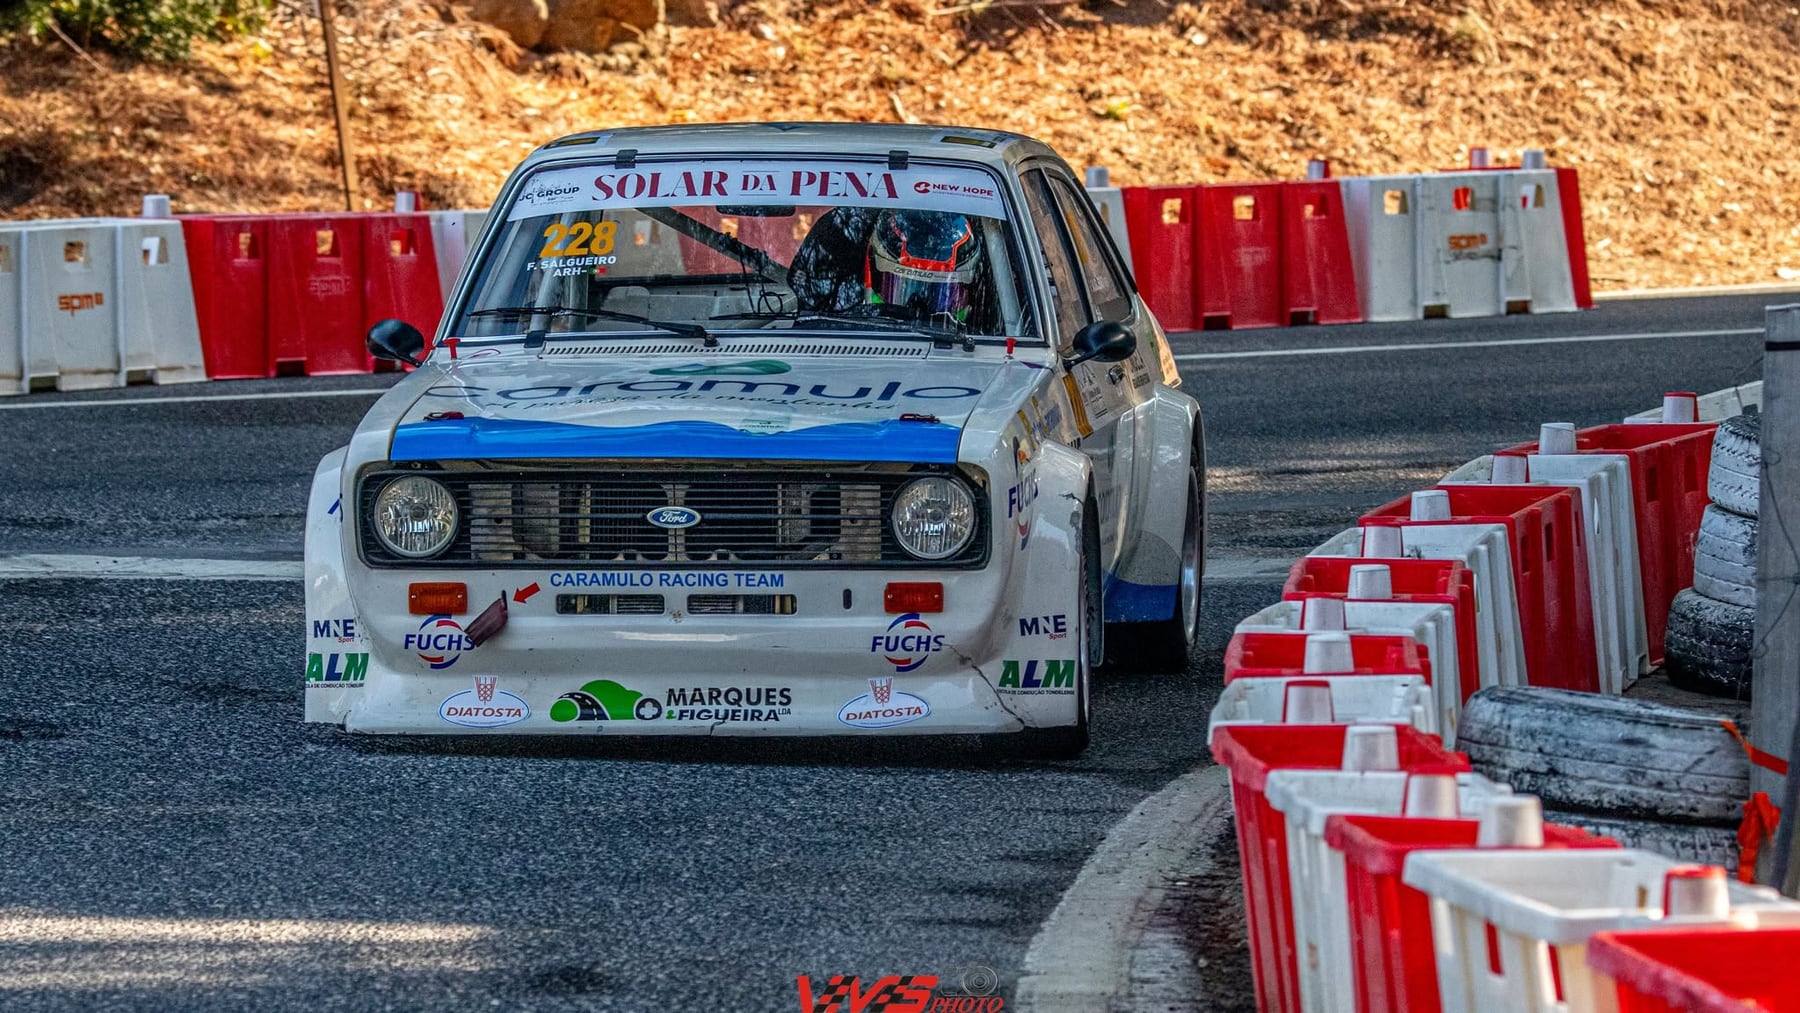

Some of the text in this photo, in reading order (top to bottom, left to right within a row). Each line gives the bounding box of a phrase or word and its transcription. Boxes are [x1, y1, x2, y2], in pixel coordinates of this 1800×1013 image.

[537, 186, 580, 198] GROUP
[591, 171, 899, 201] SOLAR DA PENA
[932, 183, 960, 192] NEW
[963, 186, 994, 197] HOPE
[539, 220, 618, 259] 228
[527, 256, 617, 271] F. SALGUEIRO
[425, 380, 982, 401] caramulo
[1008, 467, 1039, 519] FUCHS
[659, 510, 688, 523] Ford
[550, 572, 785, 588] CARAMULO RACING TEAM
[404, 633, 475, 651] FUCHS
[871, 634, 945, 652] FUCHS
[1048, 631, 1067, 640] Sport
[305, 652, 369, 682] ALM
[998, 659, 1076, 689] ALM
[666, 687, 792, 707] MARQUES
[446, 706, 522, 718] DIATOSTA
[678, 709, 780, 722] FIGUEIRA
[777, 708, 792, 716] LDA
[845, 706, 923, 721] DIATOSTA
